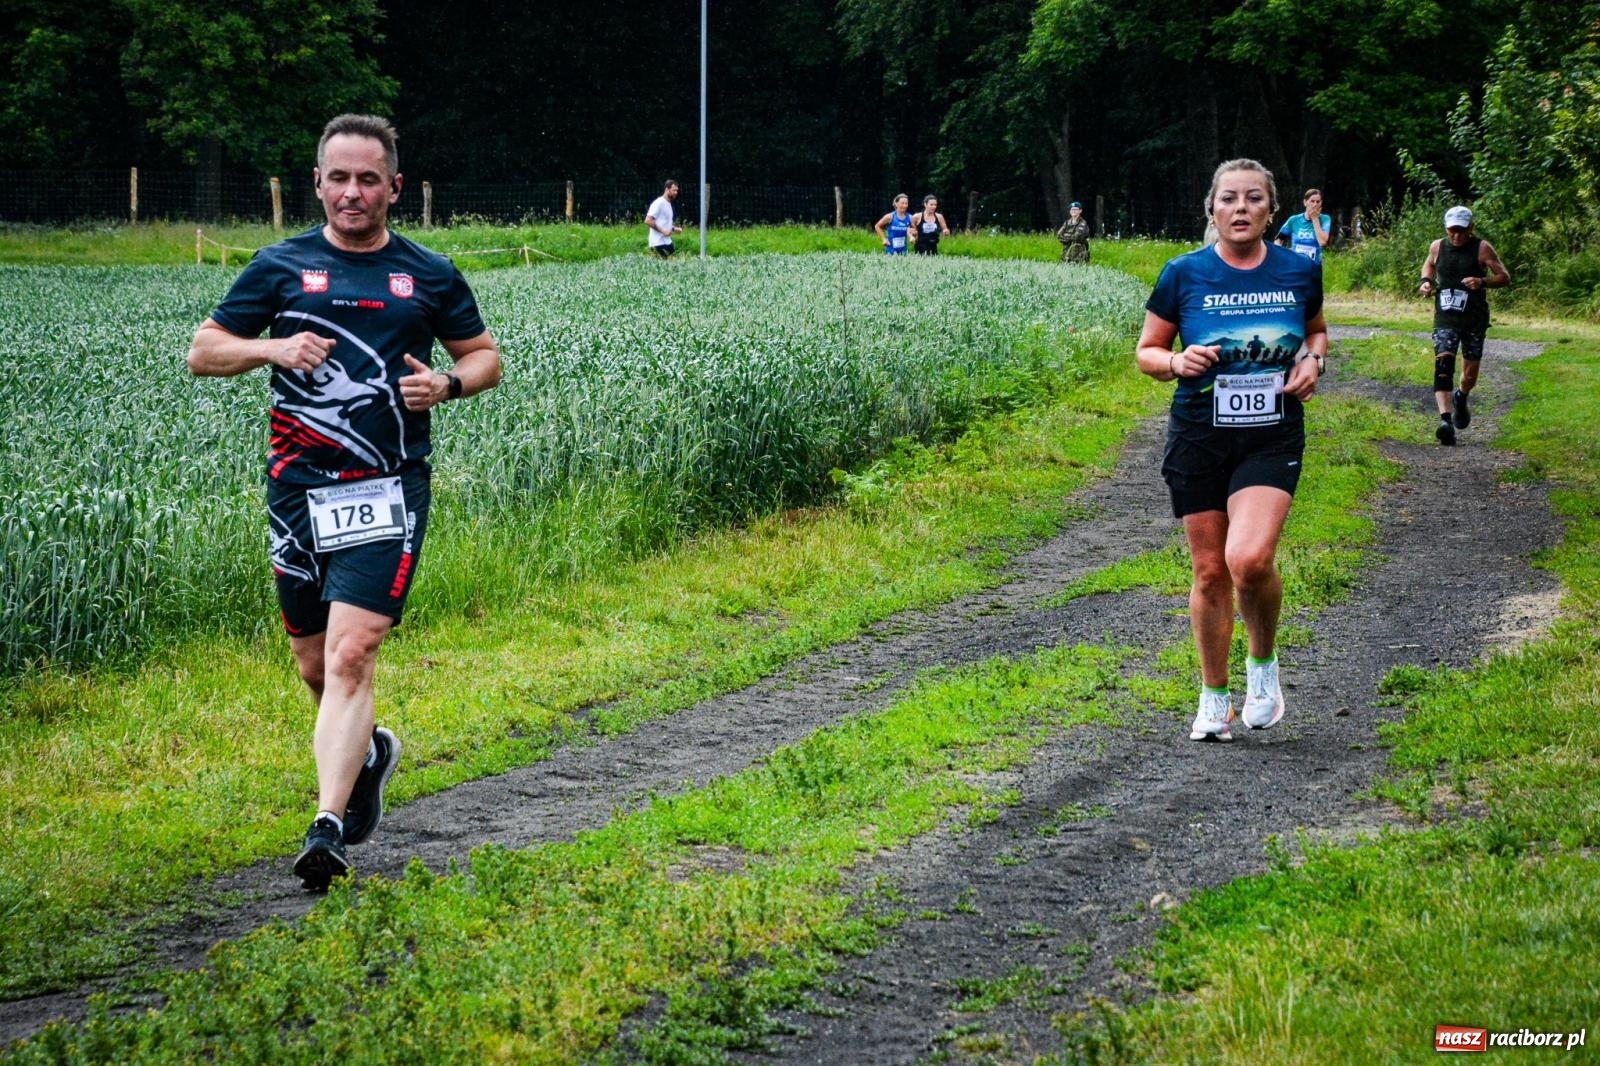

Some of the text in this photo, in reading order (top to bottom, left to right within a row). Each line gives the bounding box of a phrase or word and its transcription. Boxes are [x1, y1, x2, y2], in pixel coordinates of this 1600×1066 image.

[1203, 291, 1297, 308] STACHOWNIA
[1246, 306, 1286, 315] SPORTOWA
[1229, 393, 1266, 411] 018
[330, 504, 375, 530] 178
